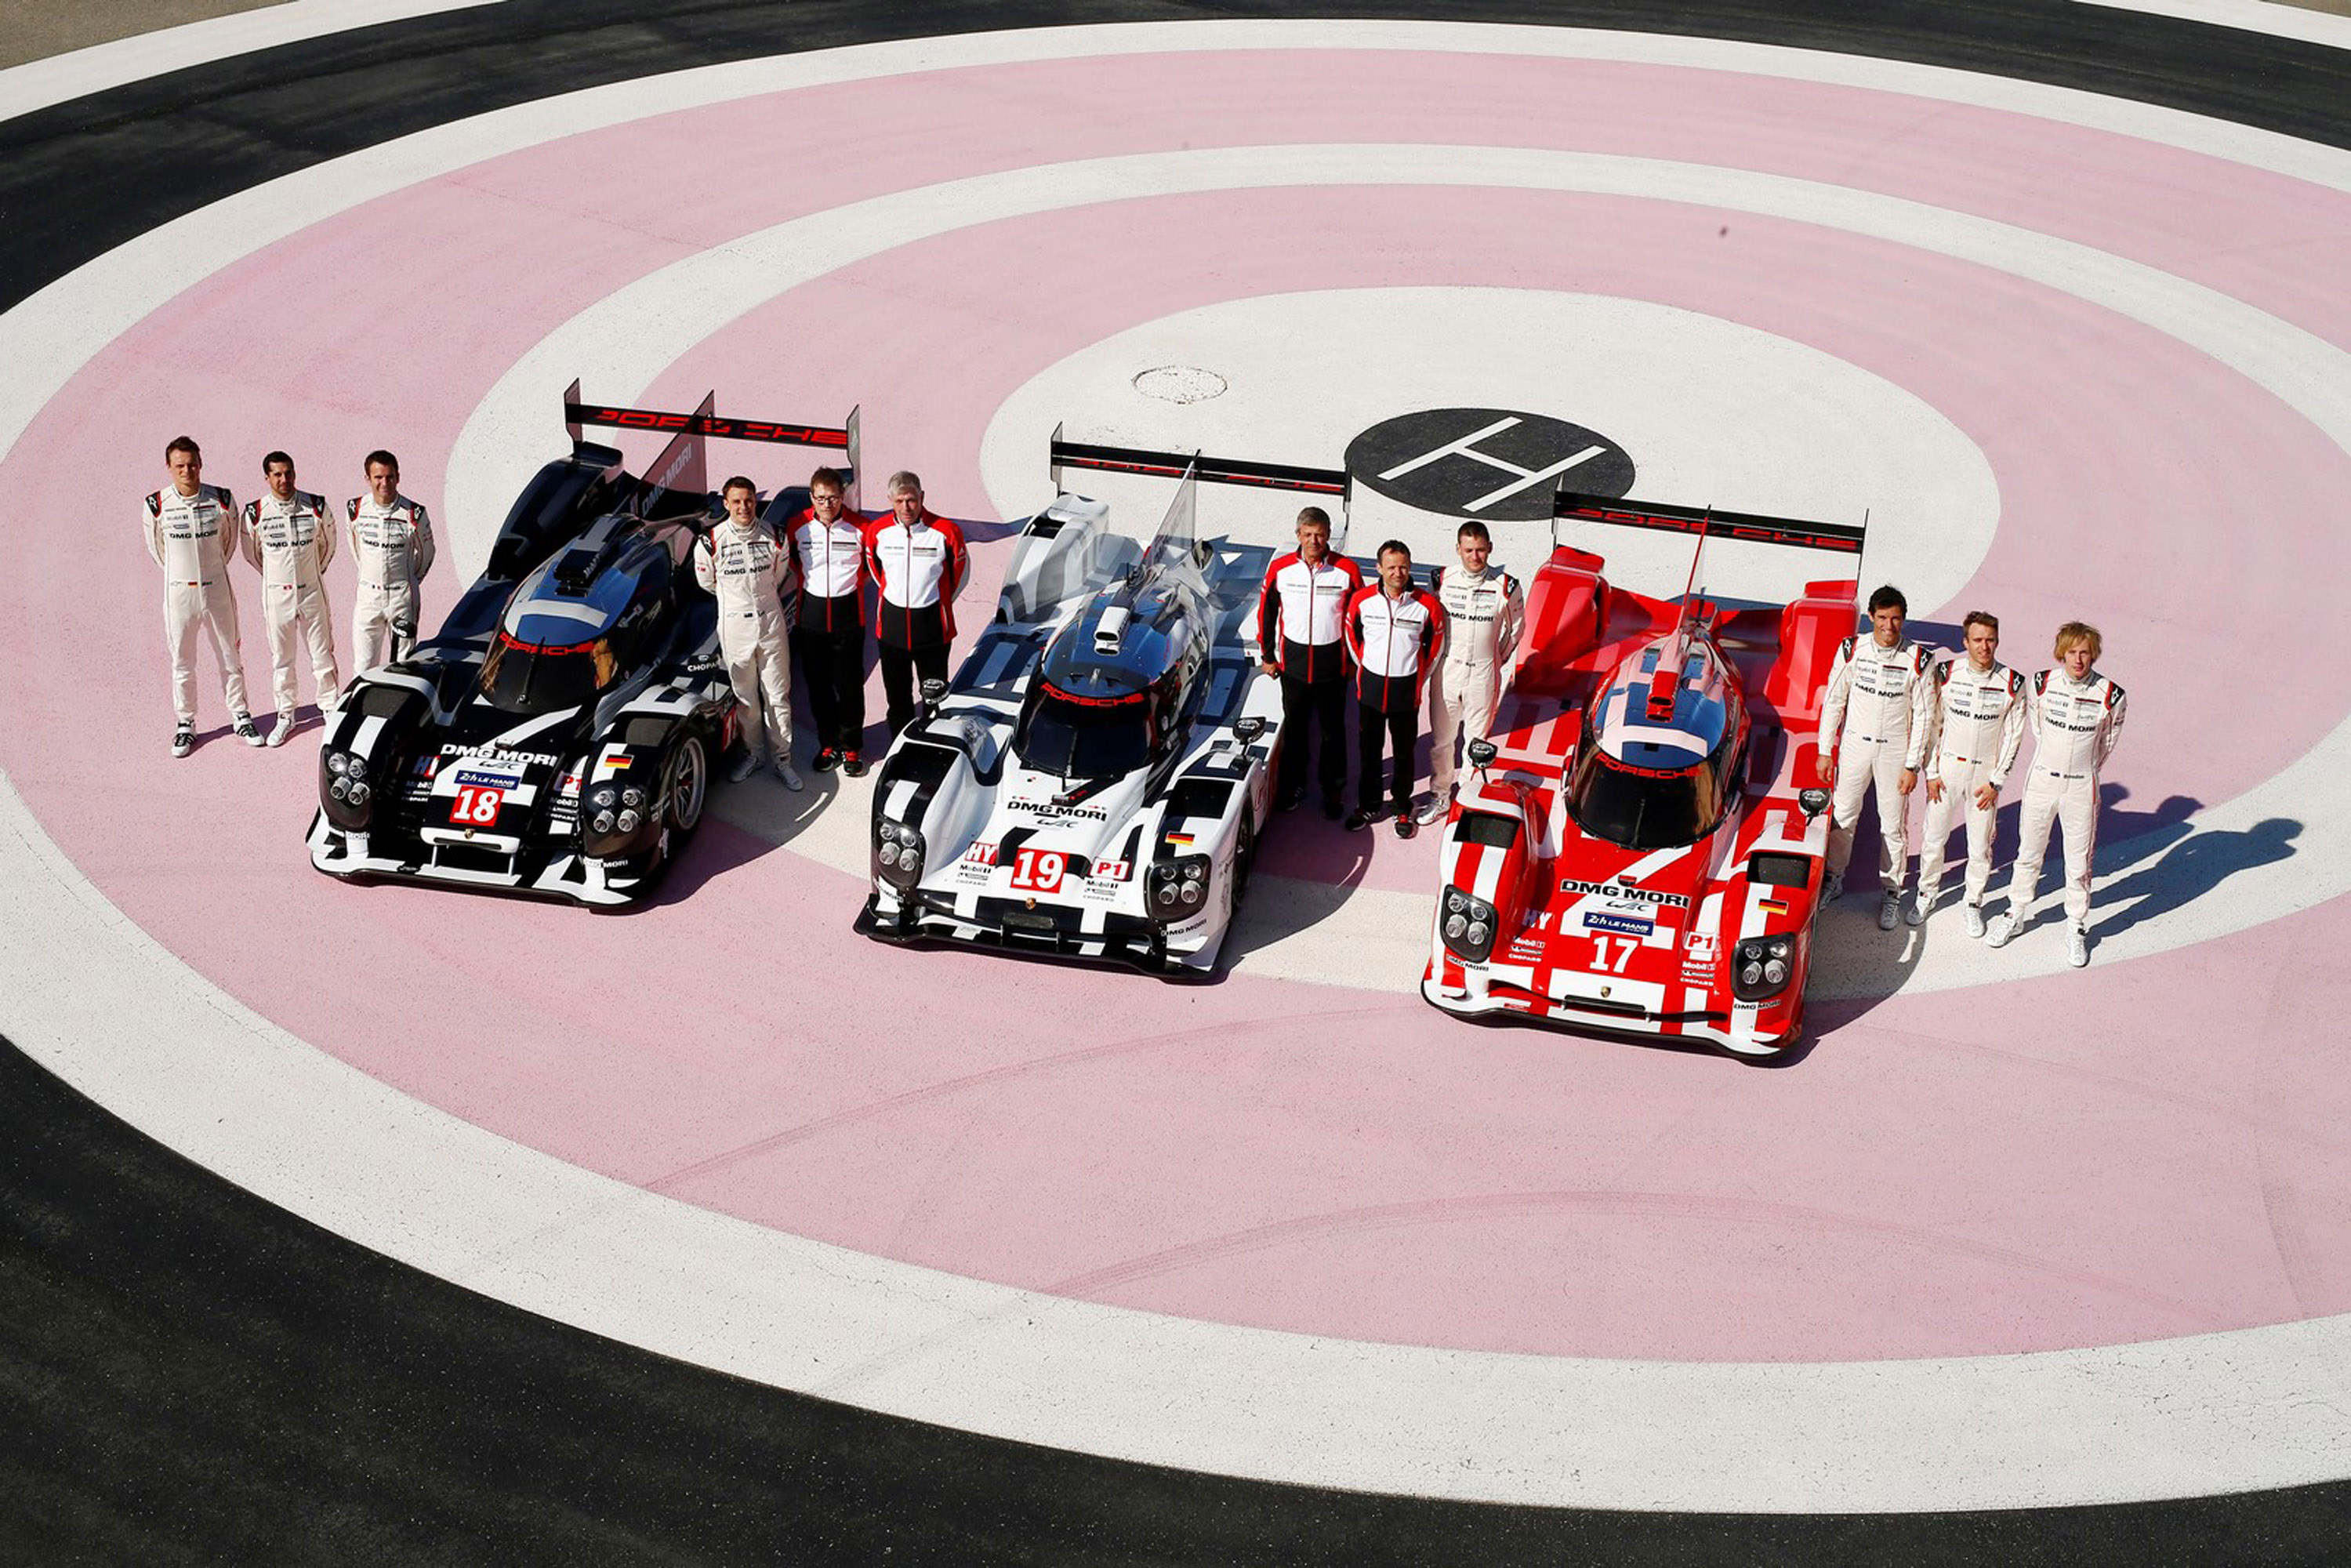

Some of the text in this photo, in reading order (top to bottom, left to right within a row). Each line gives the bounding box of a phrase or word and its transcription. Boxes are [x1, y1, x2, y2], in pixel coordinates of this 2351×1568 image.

[1040, 682, 1145, 707] PORSCHE
[441, 743, 557, 767] DMG MORI
[1595, 752, 1703, 779] PORSCHE
[452, 789, 499, 822] 18
[1007, 800, 1107, 822] DMG MORI
[604, 859, 628, 868] MORI
[967, 843, 996, 864] HY
[1013, 850, 1064, 889] 19
[1097, 862, 1122, 876] P1
[1561, 880, 1689, 908] DMG MORI
[1161, 919, 1207, 937] DMG MORI
[1522, 907, 1552, 931] HY
[1620, 922, 1649, 931] MANS
[1688, 935, 1713, 949] P1
[1589, 935, 1638, 973] 17
[1465, 963, 1489, 971] MORI
[1680, 978, 1714, 986] CHOPARD
